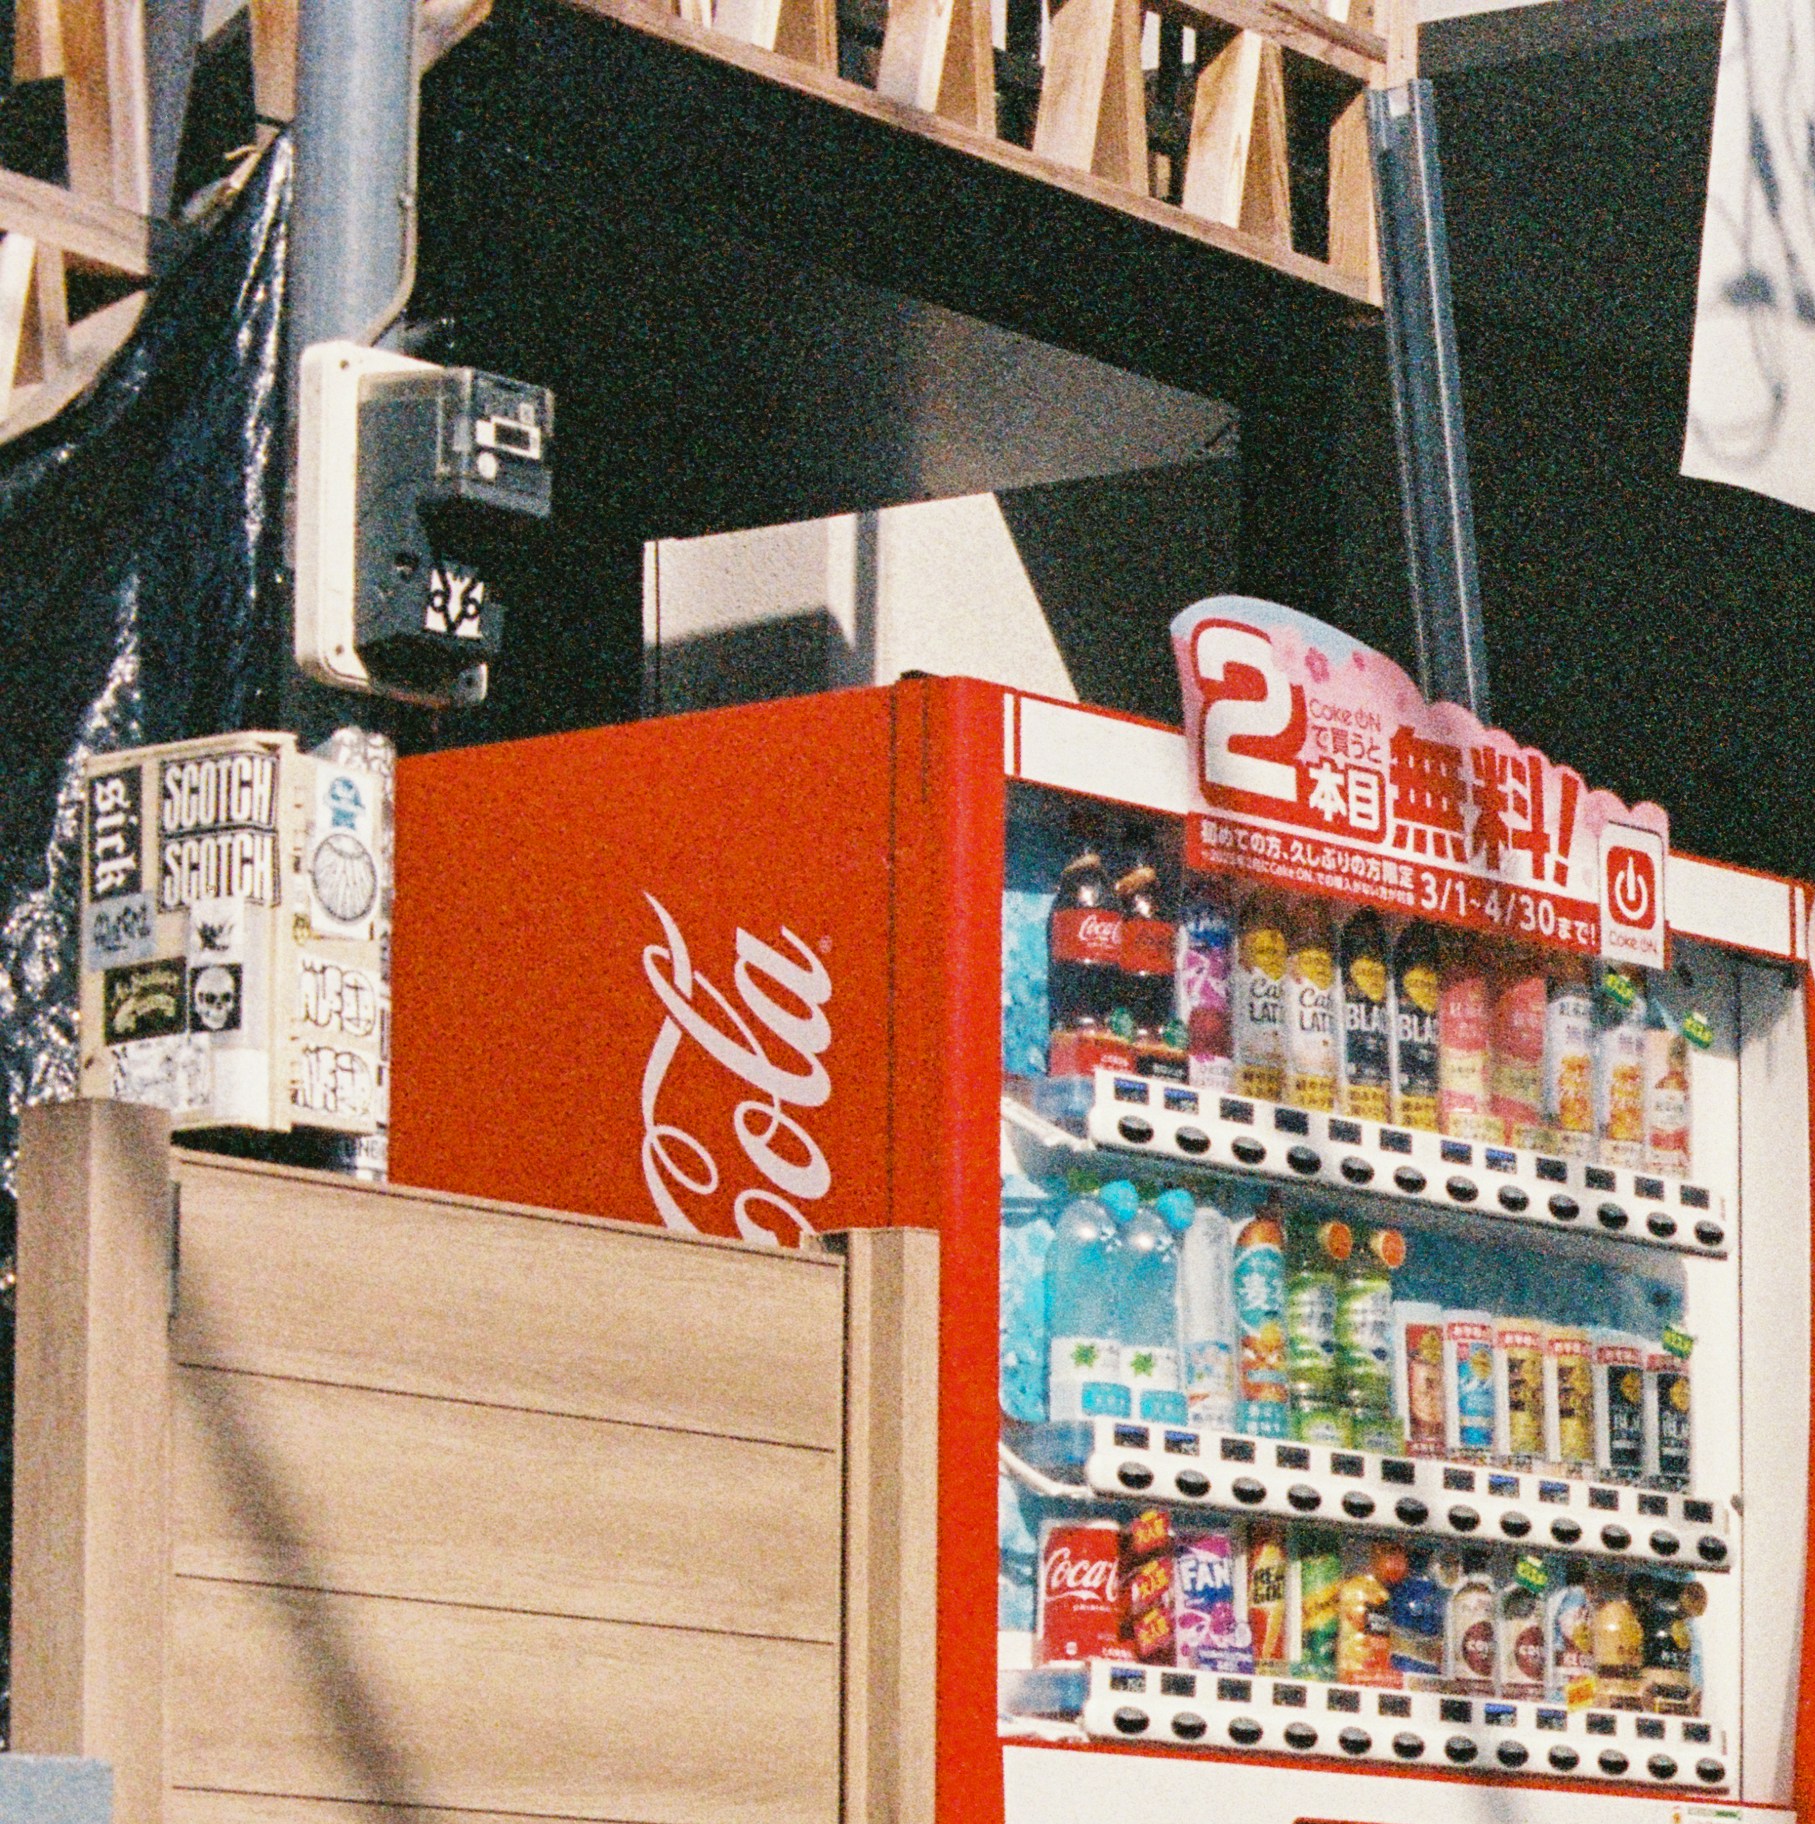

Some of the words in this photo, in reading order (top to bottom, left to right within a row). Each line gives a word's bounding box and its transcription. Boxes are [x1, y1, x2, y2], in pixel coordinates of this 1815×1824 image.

[1309, 698, 1352, 726] Coke
[1311, 725, 1382, 763] で買うと
[164, 756, 274, 830] SCOTCH
[165, 833, 276, 908] SCOTCH
